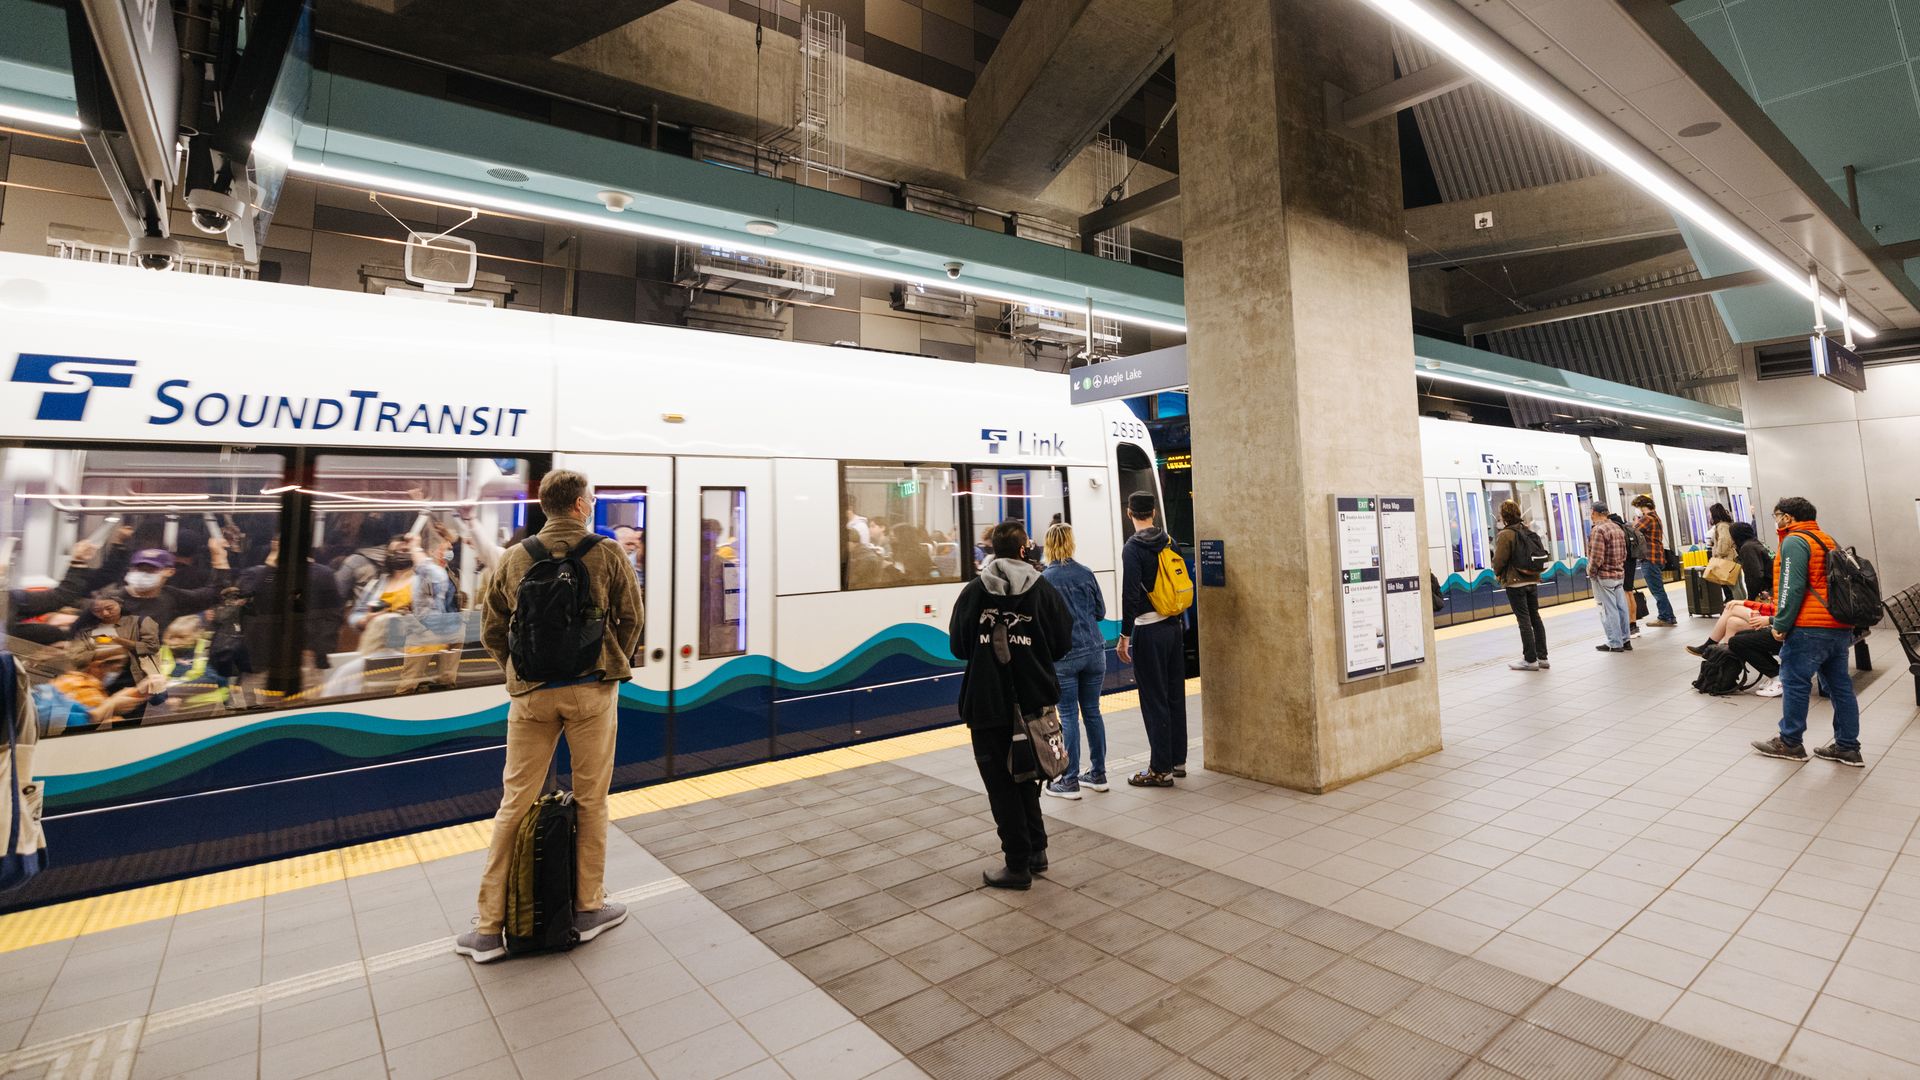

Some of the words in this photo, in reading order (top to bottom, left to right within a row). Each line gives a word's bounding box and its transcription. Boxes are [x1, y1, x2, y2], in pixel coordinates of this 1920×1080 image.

[1103, 373, 1124, 386] Angle
[1125, 368, 1142, 381] Lake
[1112, 421, 1143, 439] 283B
[1017, 430, 1065, 456] Link
[1358, 501, 1368, 509] EXIT
[1350, 572, 1360, 580] EXIT
[980, 634, 1032, 646] MANG
